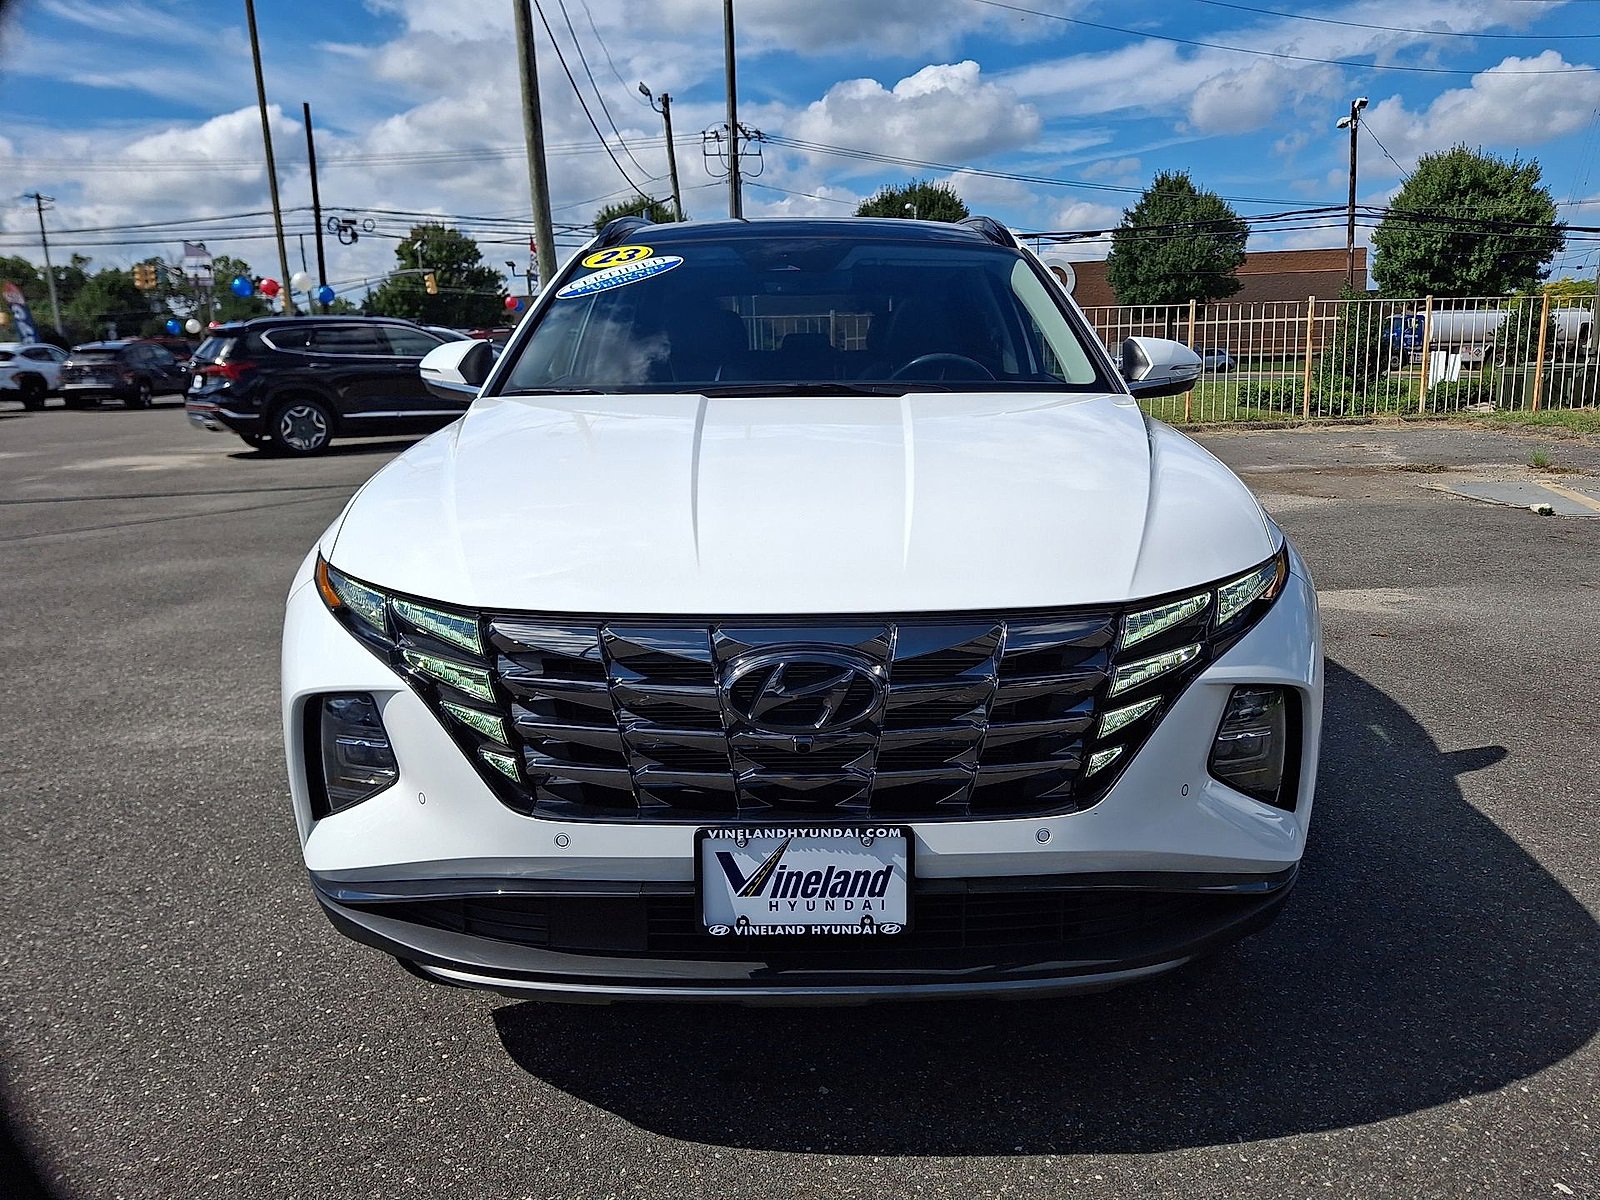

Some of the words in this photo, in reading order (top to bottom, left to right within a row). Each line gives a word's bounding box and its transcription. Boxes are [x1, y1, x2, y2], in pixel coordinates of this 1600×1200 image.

[593, 249, 641, 264] 23
[569, 258, 666, 290] CERTIFIED
[708, 829, 901, 839] VINELANDHYUNDAI.COM
[714, 838, 894, 899] Vineland
[768, 899, 885, 912] HYUNDAI
[734, 925, 806, 935] VINELAND
[811, 925, 877, 935] HYUNDAI
